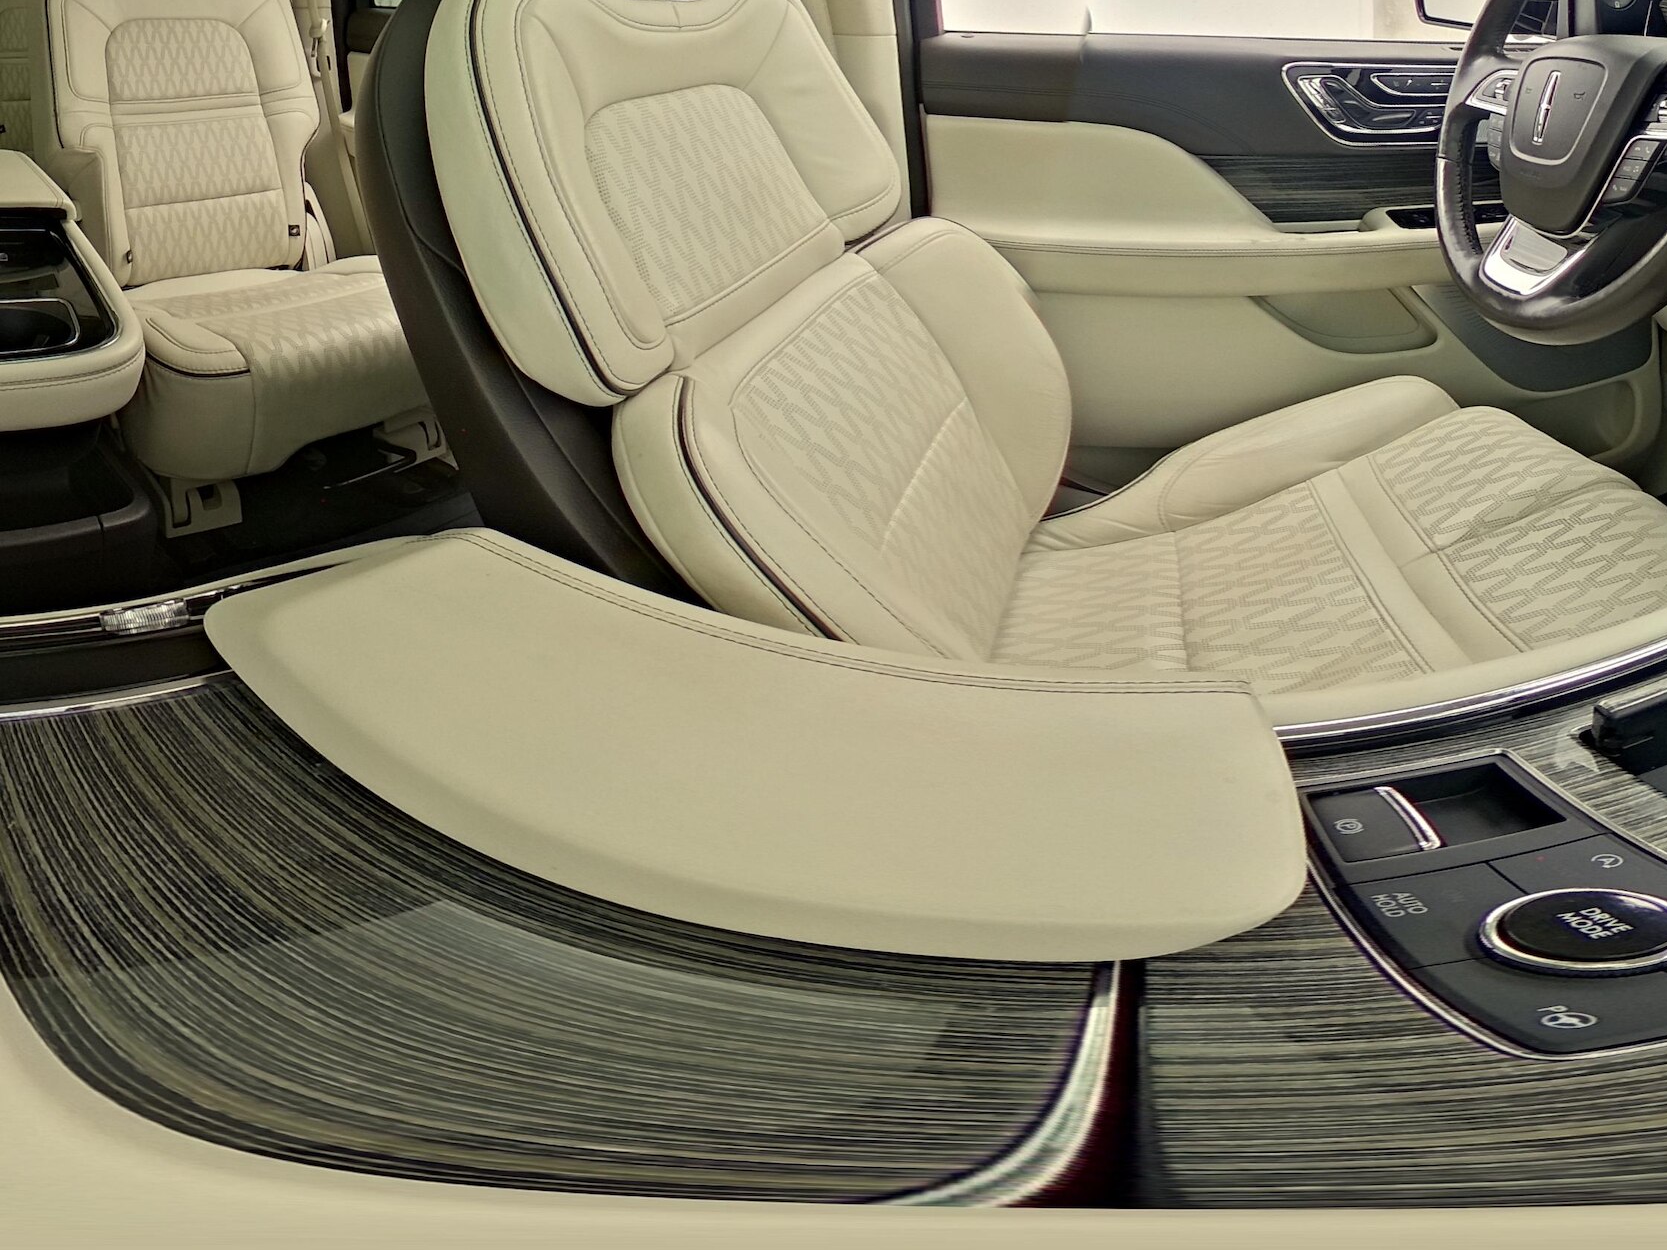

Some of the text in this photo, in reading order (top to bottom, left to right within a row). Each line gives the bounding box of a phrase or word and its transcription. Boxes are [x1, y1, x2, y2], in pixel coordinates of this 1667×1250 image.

[1370, 893, 1406, 918] HOLD
[1391, 892, 1428, 914] AUTO
[1555, 912, 1614, 940] MODE
[1579, 907, 1634, 933] DRIVE
